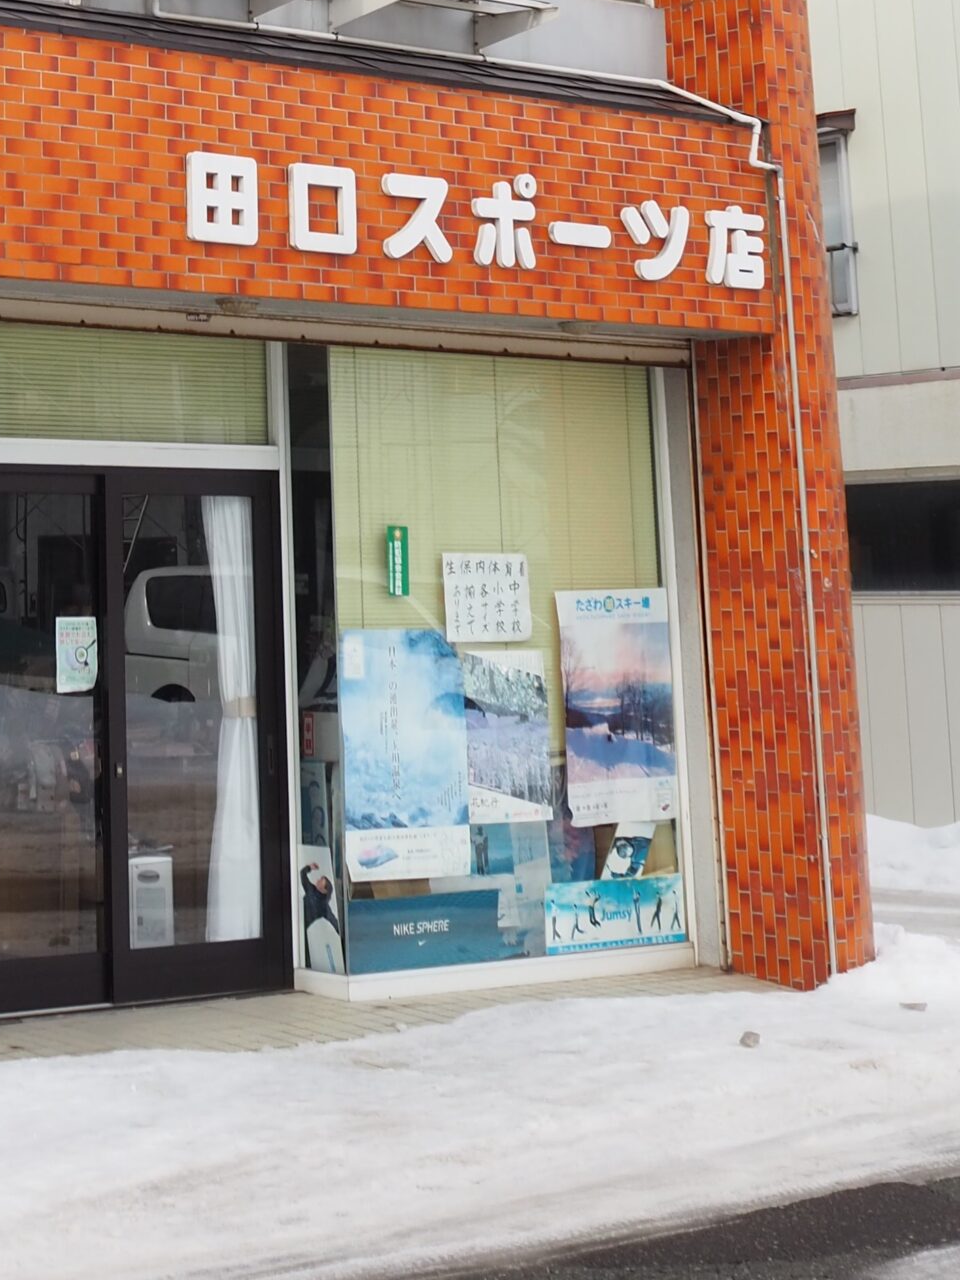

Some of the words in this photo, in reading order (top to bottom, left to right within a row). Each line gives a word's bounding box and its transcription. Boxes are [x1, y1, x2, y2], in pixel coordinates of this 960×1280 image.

[186, 150, 765, 290] 田口スポーツ店
[493, 580, 507, 633] 小学校
[508, 580, 522, 633] 中学校
[393, 922, 415, 937] NIKE
[416, 919, 450, 935] SPHERE
